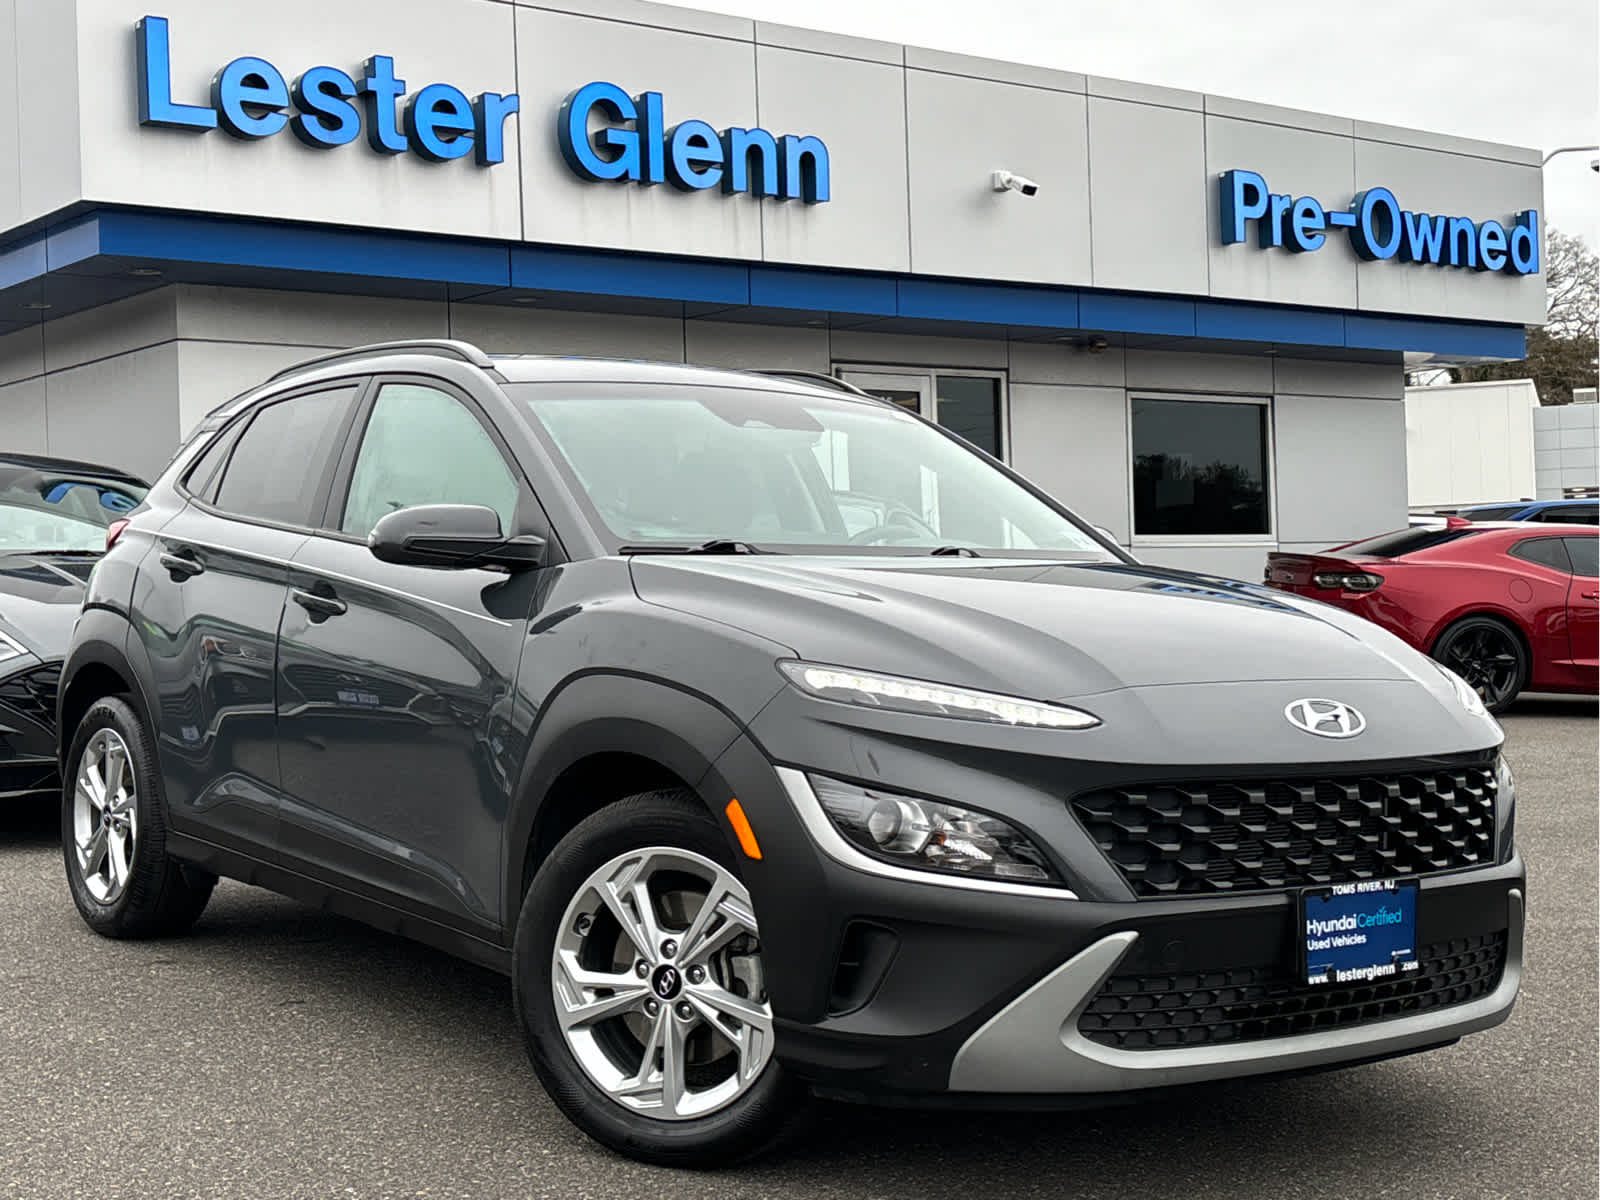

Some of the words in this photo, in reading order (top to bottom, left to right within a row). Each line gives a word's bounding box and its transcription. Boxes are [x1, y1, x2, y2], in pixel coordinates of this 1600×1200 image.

[136, 16, 520, 167] Lester
[558, 81, 830, 204] Glenn
[1219, 169, 1539, 276] Pre-Owned
[1332, 884, 1356, 896] TOMS
[1384, 879, 1396, 889] NJ
[1306, 914, 1357, 936] Hyundai
[1357, 905, 1402, 928] Certified
[1306, 937, 1331, 951] Used
[1331, 933, 1367, 948] Vehicles
[1336, 963, 1396, 983] lesterglenn
